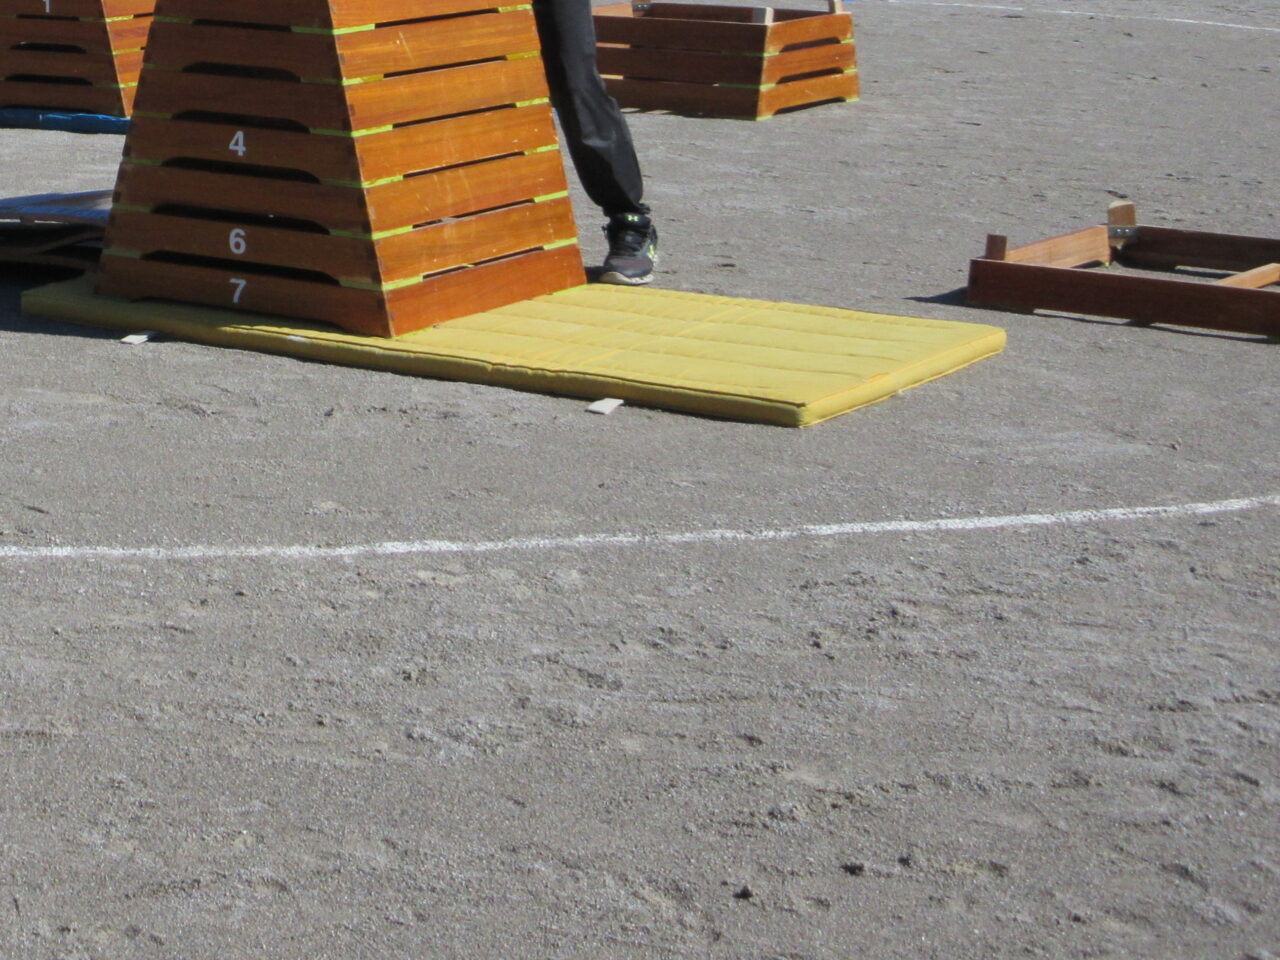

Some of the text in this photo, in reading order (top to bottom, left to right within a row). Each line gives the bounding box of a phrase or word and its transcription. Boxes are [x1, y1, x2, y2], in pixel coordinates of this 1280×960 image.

[228, 130, 247, 157] 4
[228, 228, 247, 254] 6
[228, 278, 247, 303] 7
